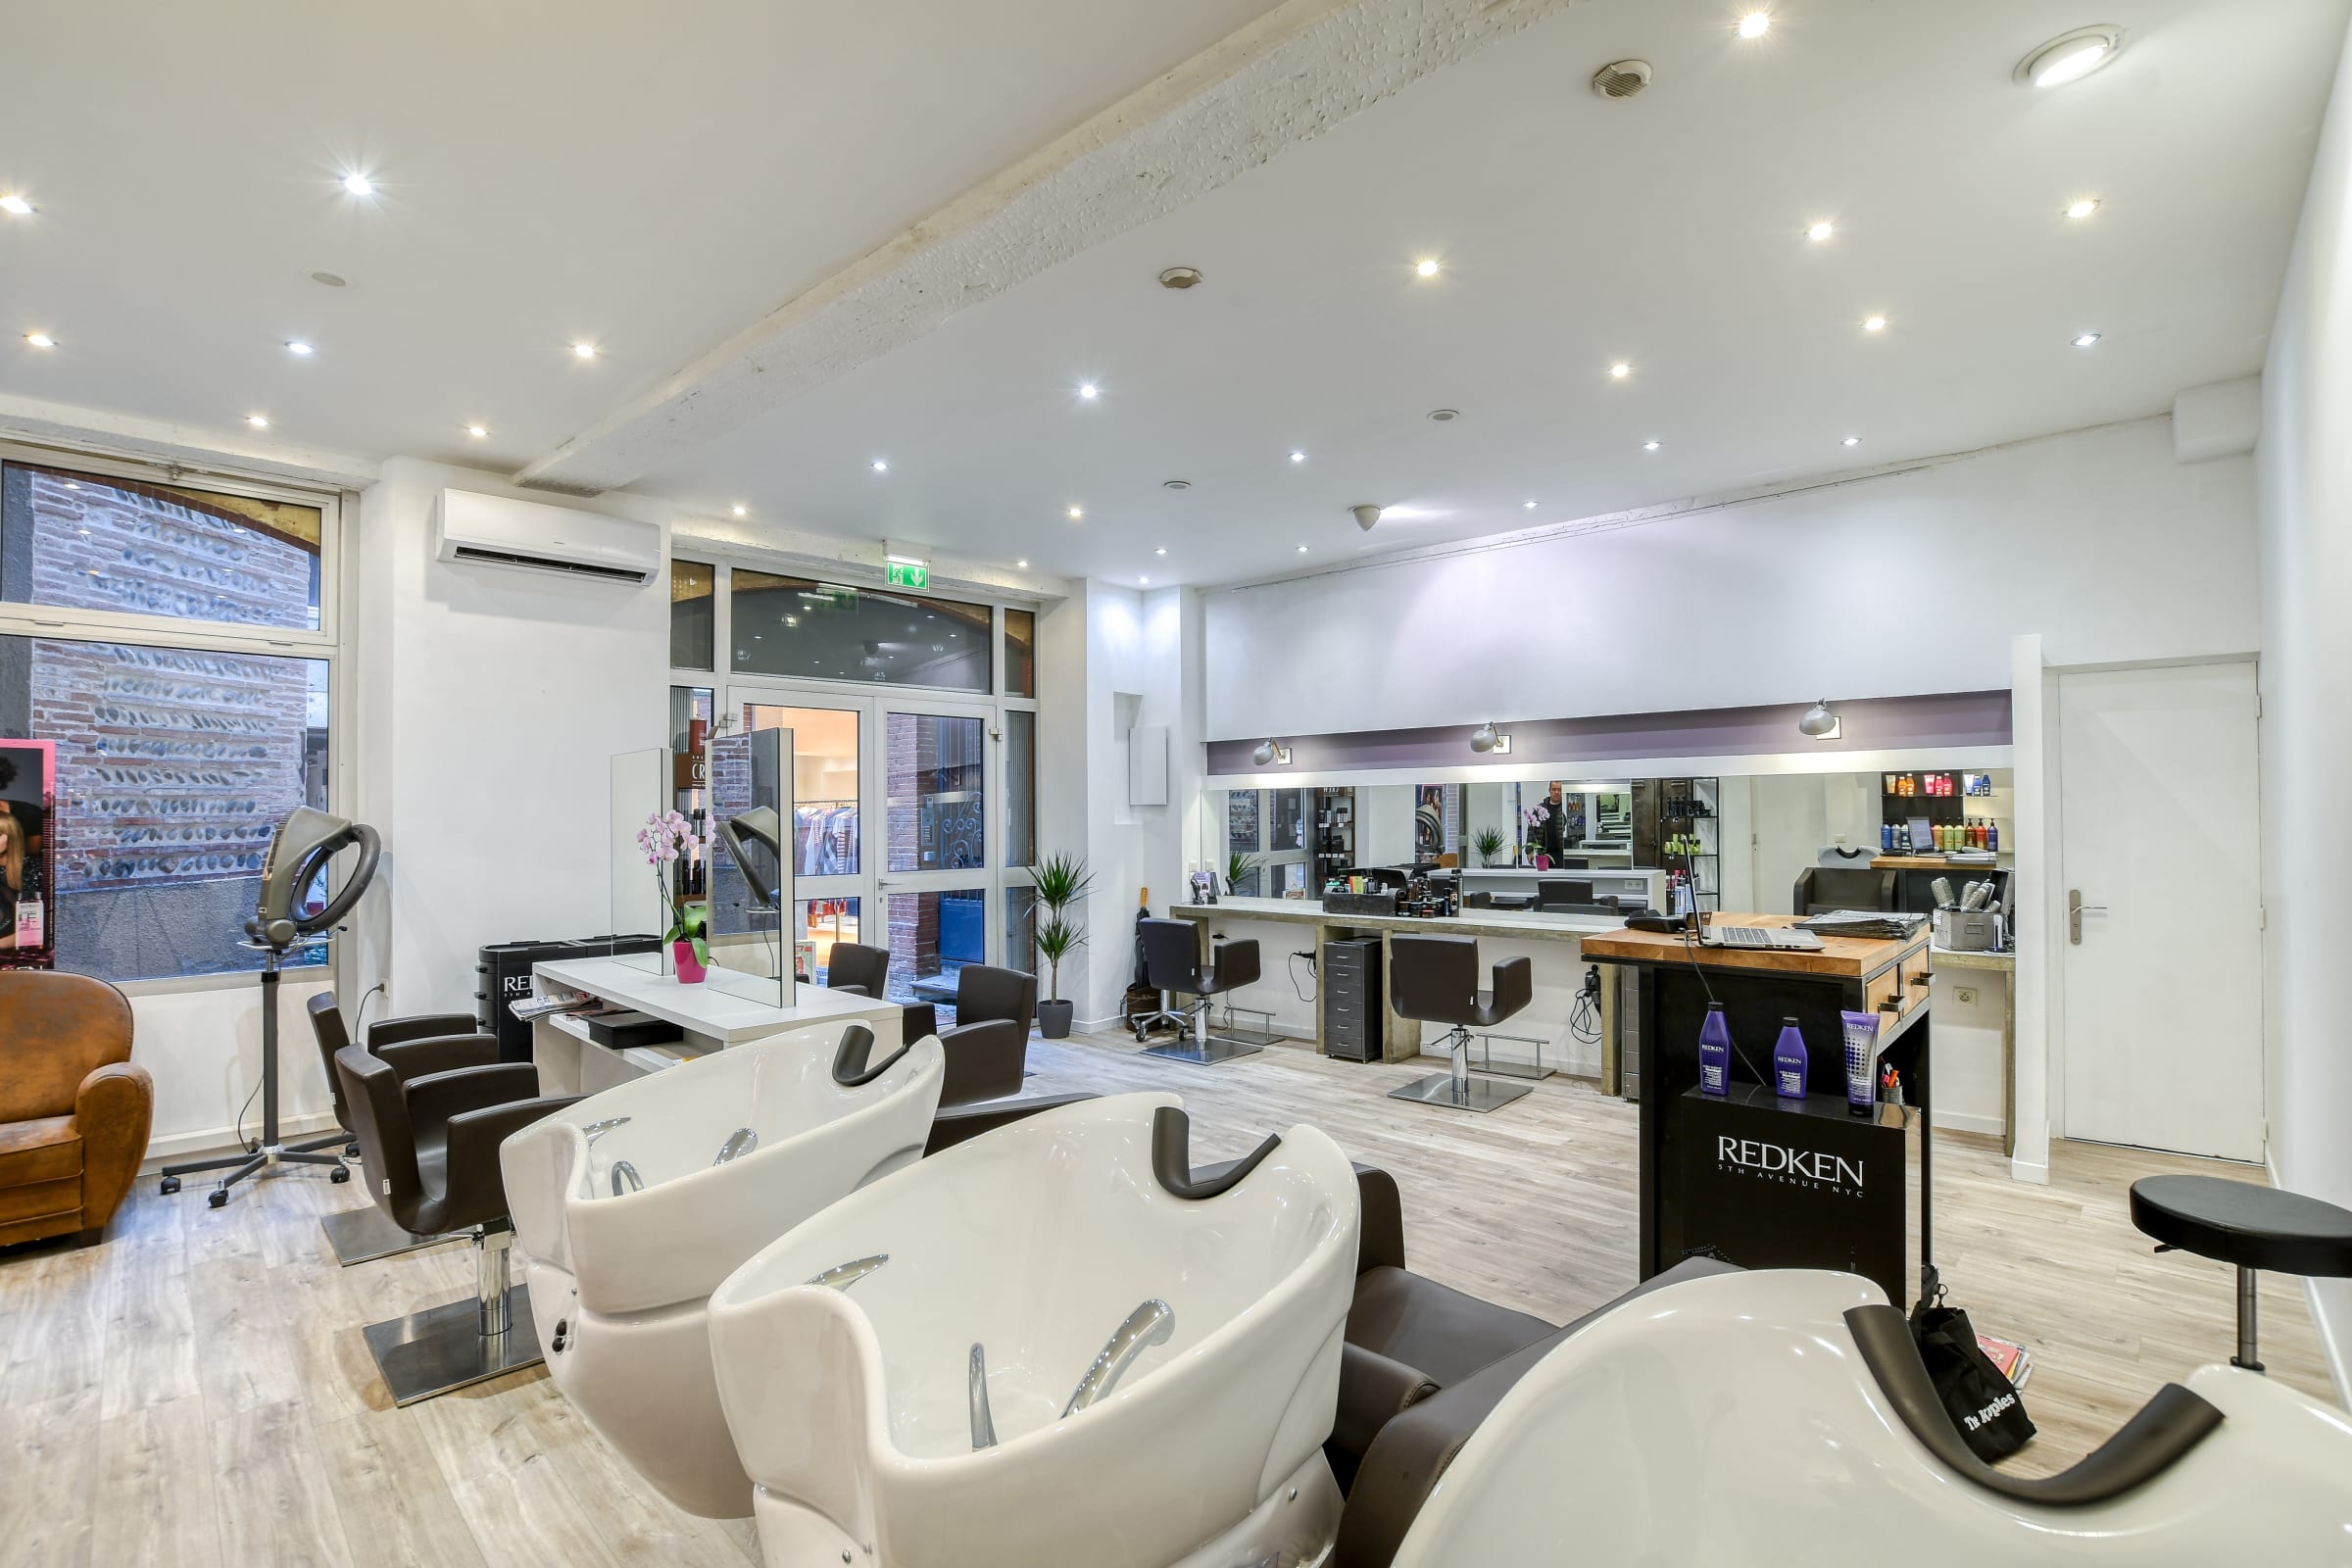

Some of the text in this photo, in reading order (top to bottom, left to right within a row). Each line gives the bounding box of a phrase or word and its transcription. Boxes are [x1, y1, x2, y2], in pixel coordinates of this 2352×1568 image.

[692, 763, 706, 780] CR
[504, 975, 533, 992] RE
[1846, 1022, 1874, 1032] REDKEN
[1701, 1044, 1725, 1053] REDKEN
[1777, 1055, 1802, 1064] REDKEN
[1718, 1135, 1864, 1187] REDKEN
[1718, 1163, 1864, 1199] 5TH AVENUE NYC
